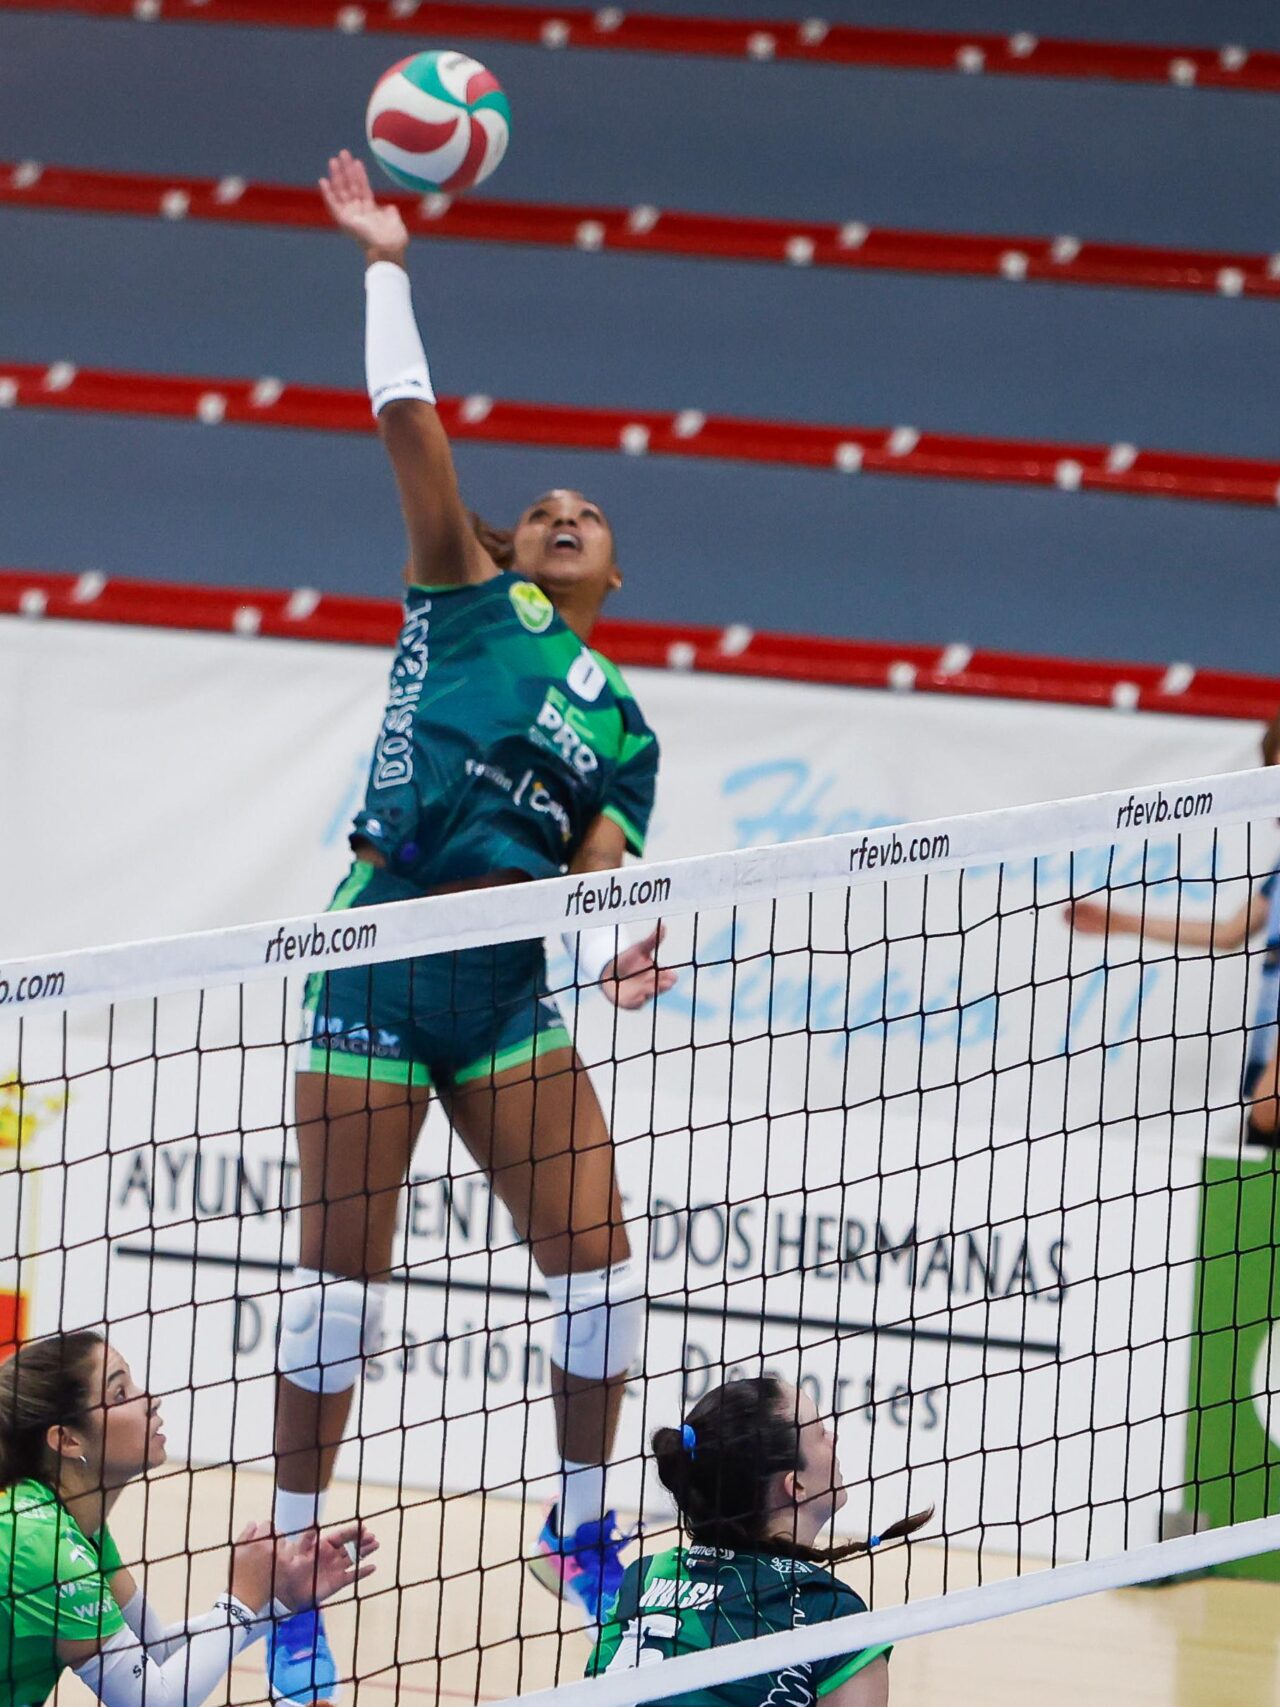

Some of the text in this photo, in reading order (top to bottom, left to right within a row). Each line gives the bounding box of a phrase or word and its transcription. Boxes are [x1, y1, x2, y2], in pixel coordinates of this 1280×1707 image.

[536, 700, 600, 775] PRO
[1115, 790, 1213, 829] rfevb.com
[849, 832, 951, 872] rfevb.com
[565, 875, 672, 917] rfevb.com
[264, 921, 378, 964] rfevb.com
[118, 1149, 524, 1247] AYUNTENT
[774, 1209, 1072, 1304] HERMANAS
[639, 1577, 725, 1612] WALSH
